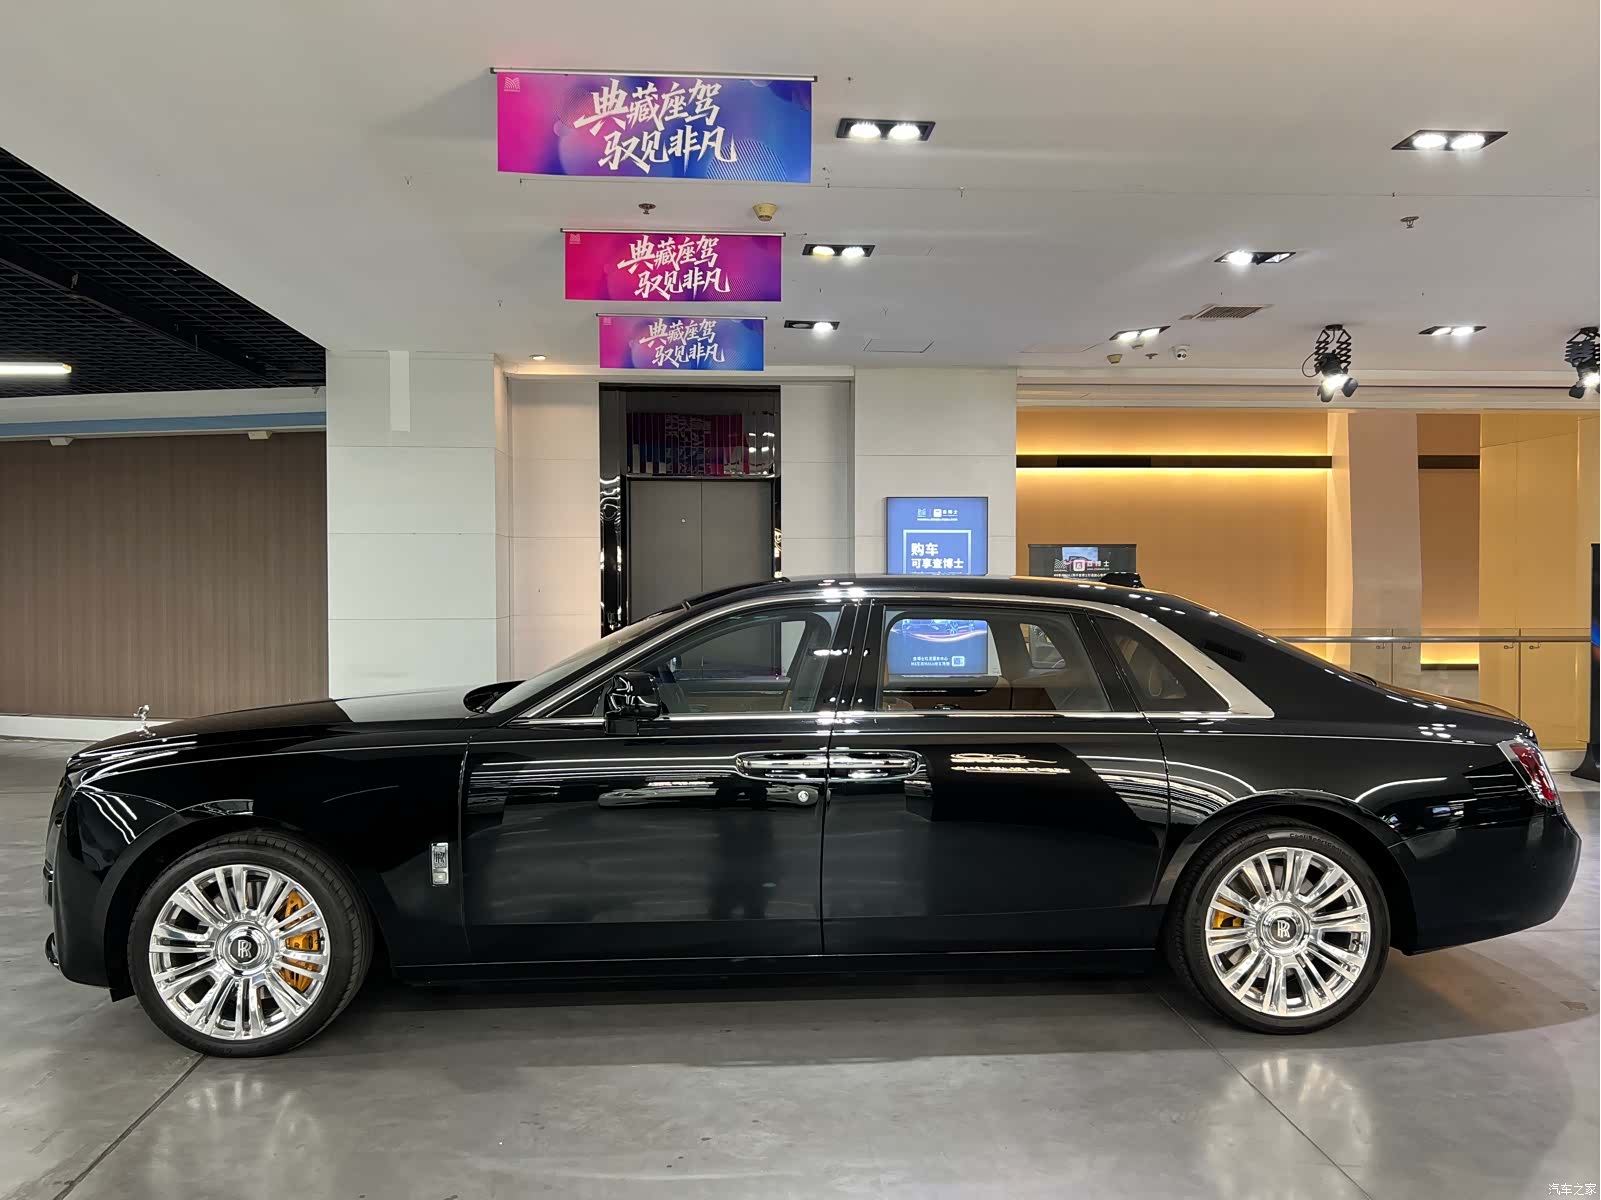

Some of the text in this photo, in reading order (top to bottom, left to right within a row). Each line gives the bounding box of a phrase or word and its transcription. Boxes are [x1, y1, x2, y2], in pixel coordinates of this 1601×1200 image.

[573, 78, 722, 136] 典藏座驾
[597, 125, 737, 174] 驭见非凡
[617, 234, 720, 274] 典藏座驾
[634, 267, 730, 300] 驭见非凡
[639, 318, 716, 347] 典藏座驾
[651, 343, 726, 368] 驭见非凡
[911, 542, 939, 556] 购车
